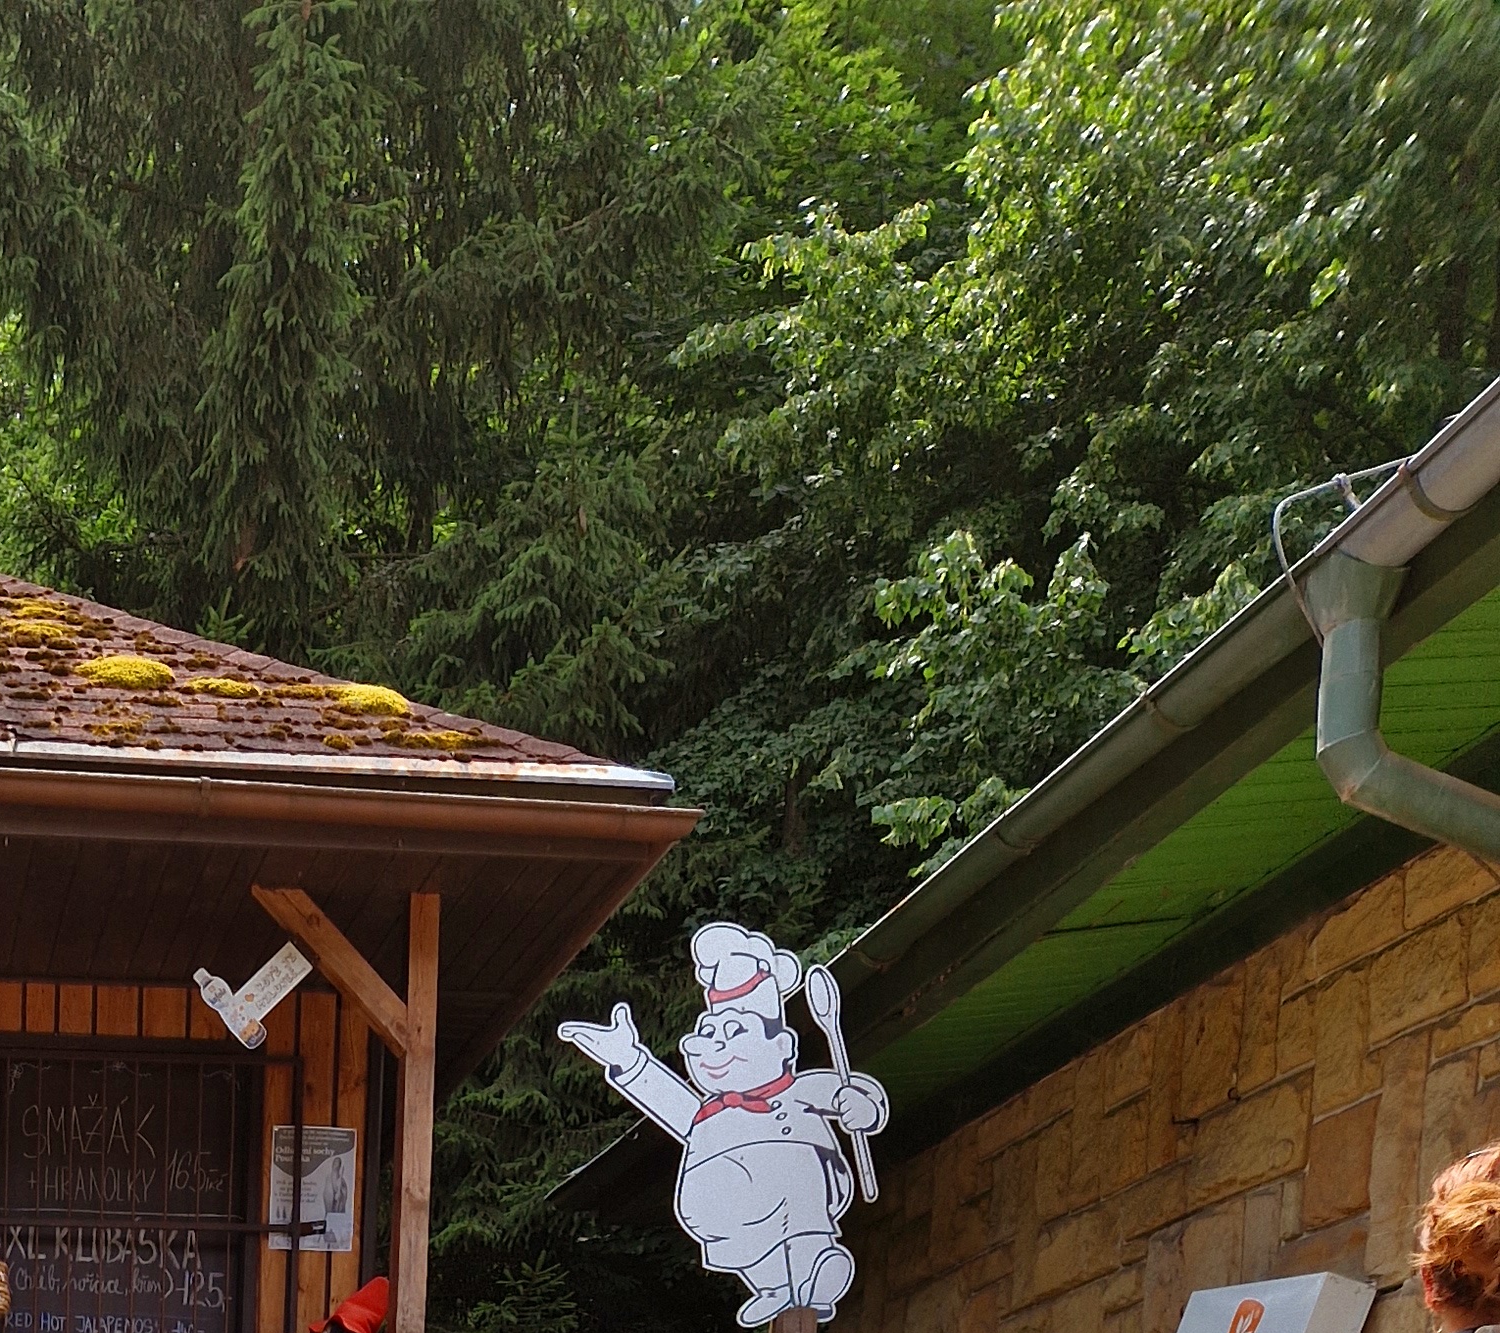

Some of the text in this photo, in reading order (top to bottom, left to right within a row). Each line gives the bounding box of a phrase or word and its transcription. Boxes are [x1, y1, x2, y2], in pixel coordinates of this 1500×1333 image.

[22, 1094, 156, 1158] SMAŽÁK
[5, 1226, 47, 1259] XL
[41, 1314, 66, 1331] HOT
